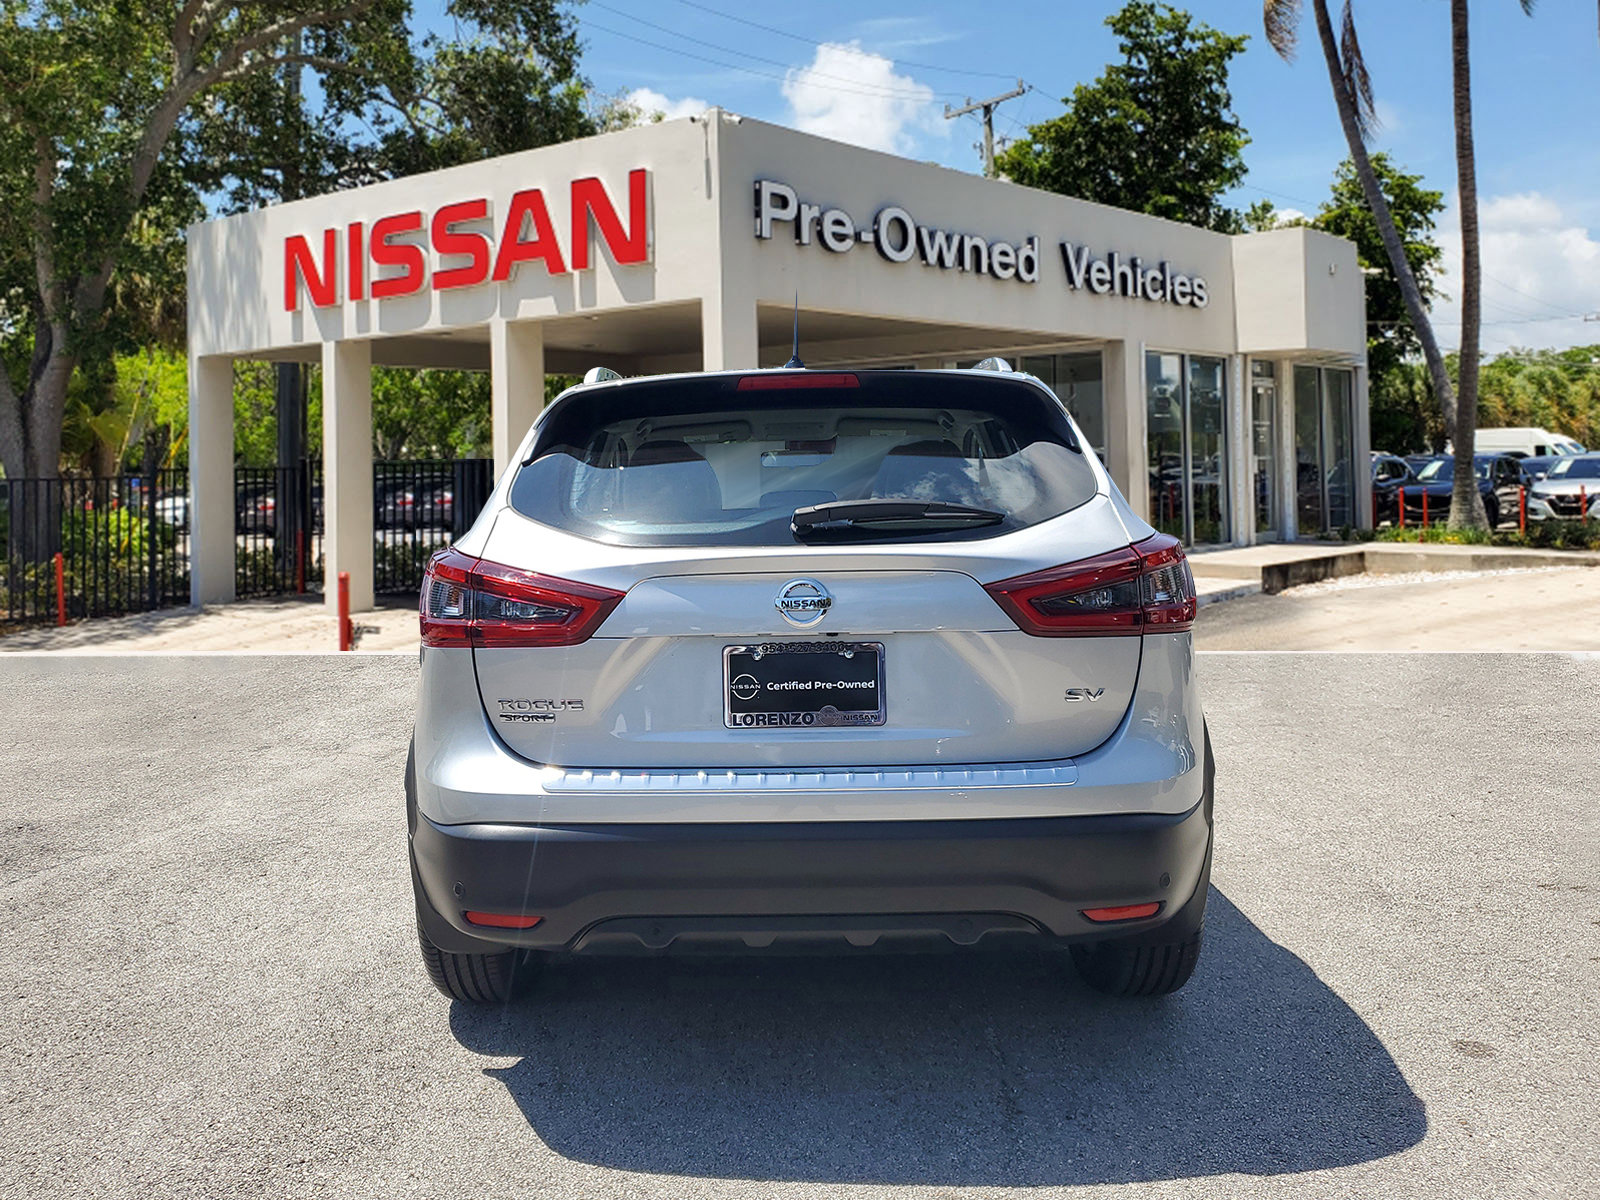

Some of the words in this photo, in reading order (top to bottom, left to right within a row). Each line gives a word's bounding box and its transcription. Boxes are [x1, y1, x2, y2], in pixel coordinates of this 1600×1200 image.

[284, 167, 648, 312] NISSAN
[754, 179, 1040, 284] Pre-Owned
[1060, 241, 1209, 308] Vehicles
[780, 599, 827, 609] NISSAN
[767, 681, 812, 691] Certified
[814, 679, 875, 690] Pre-Owned
[1064, 687, 1105, 703] SV
[498, 699, 584, 711] ROGUE
[503, 714, 550, 722] SPORT
[732, 712, 815, 727] LORENZO
